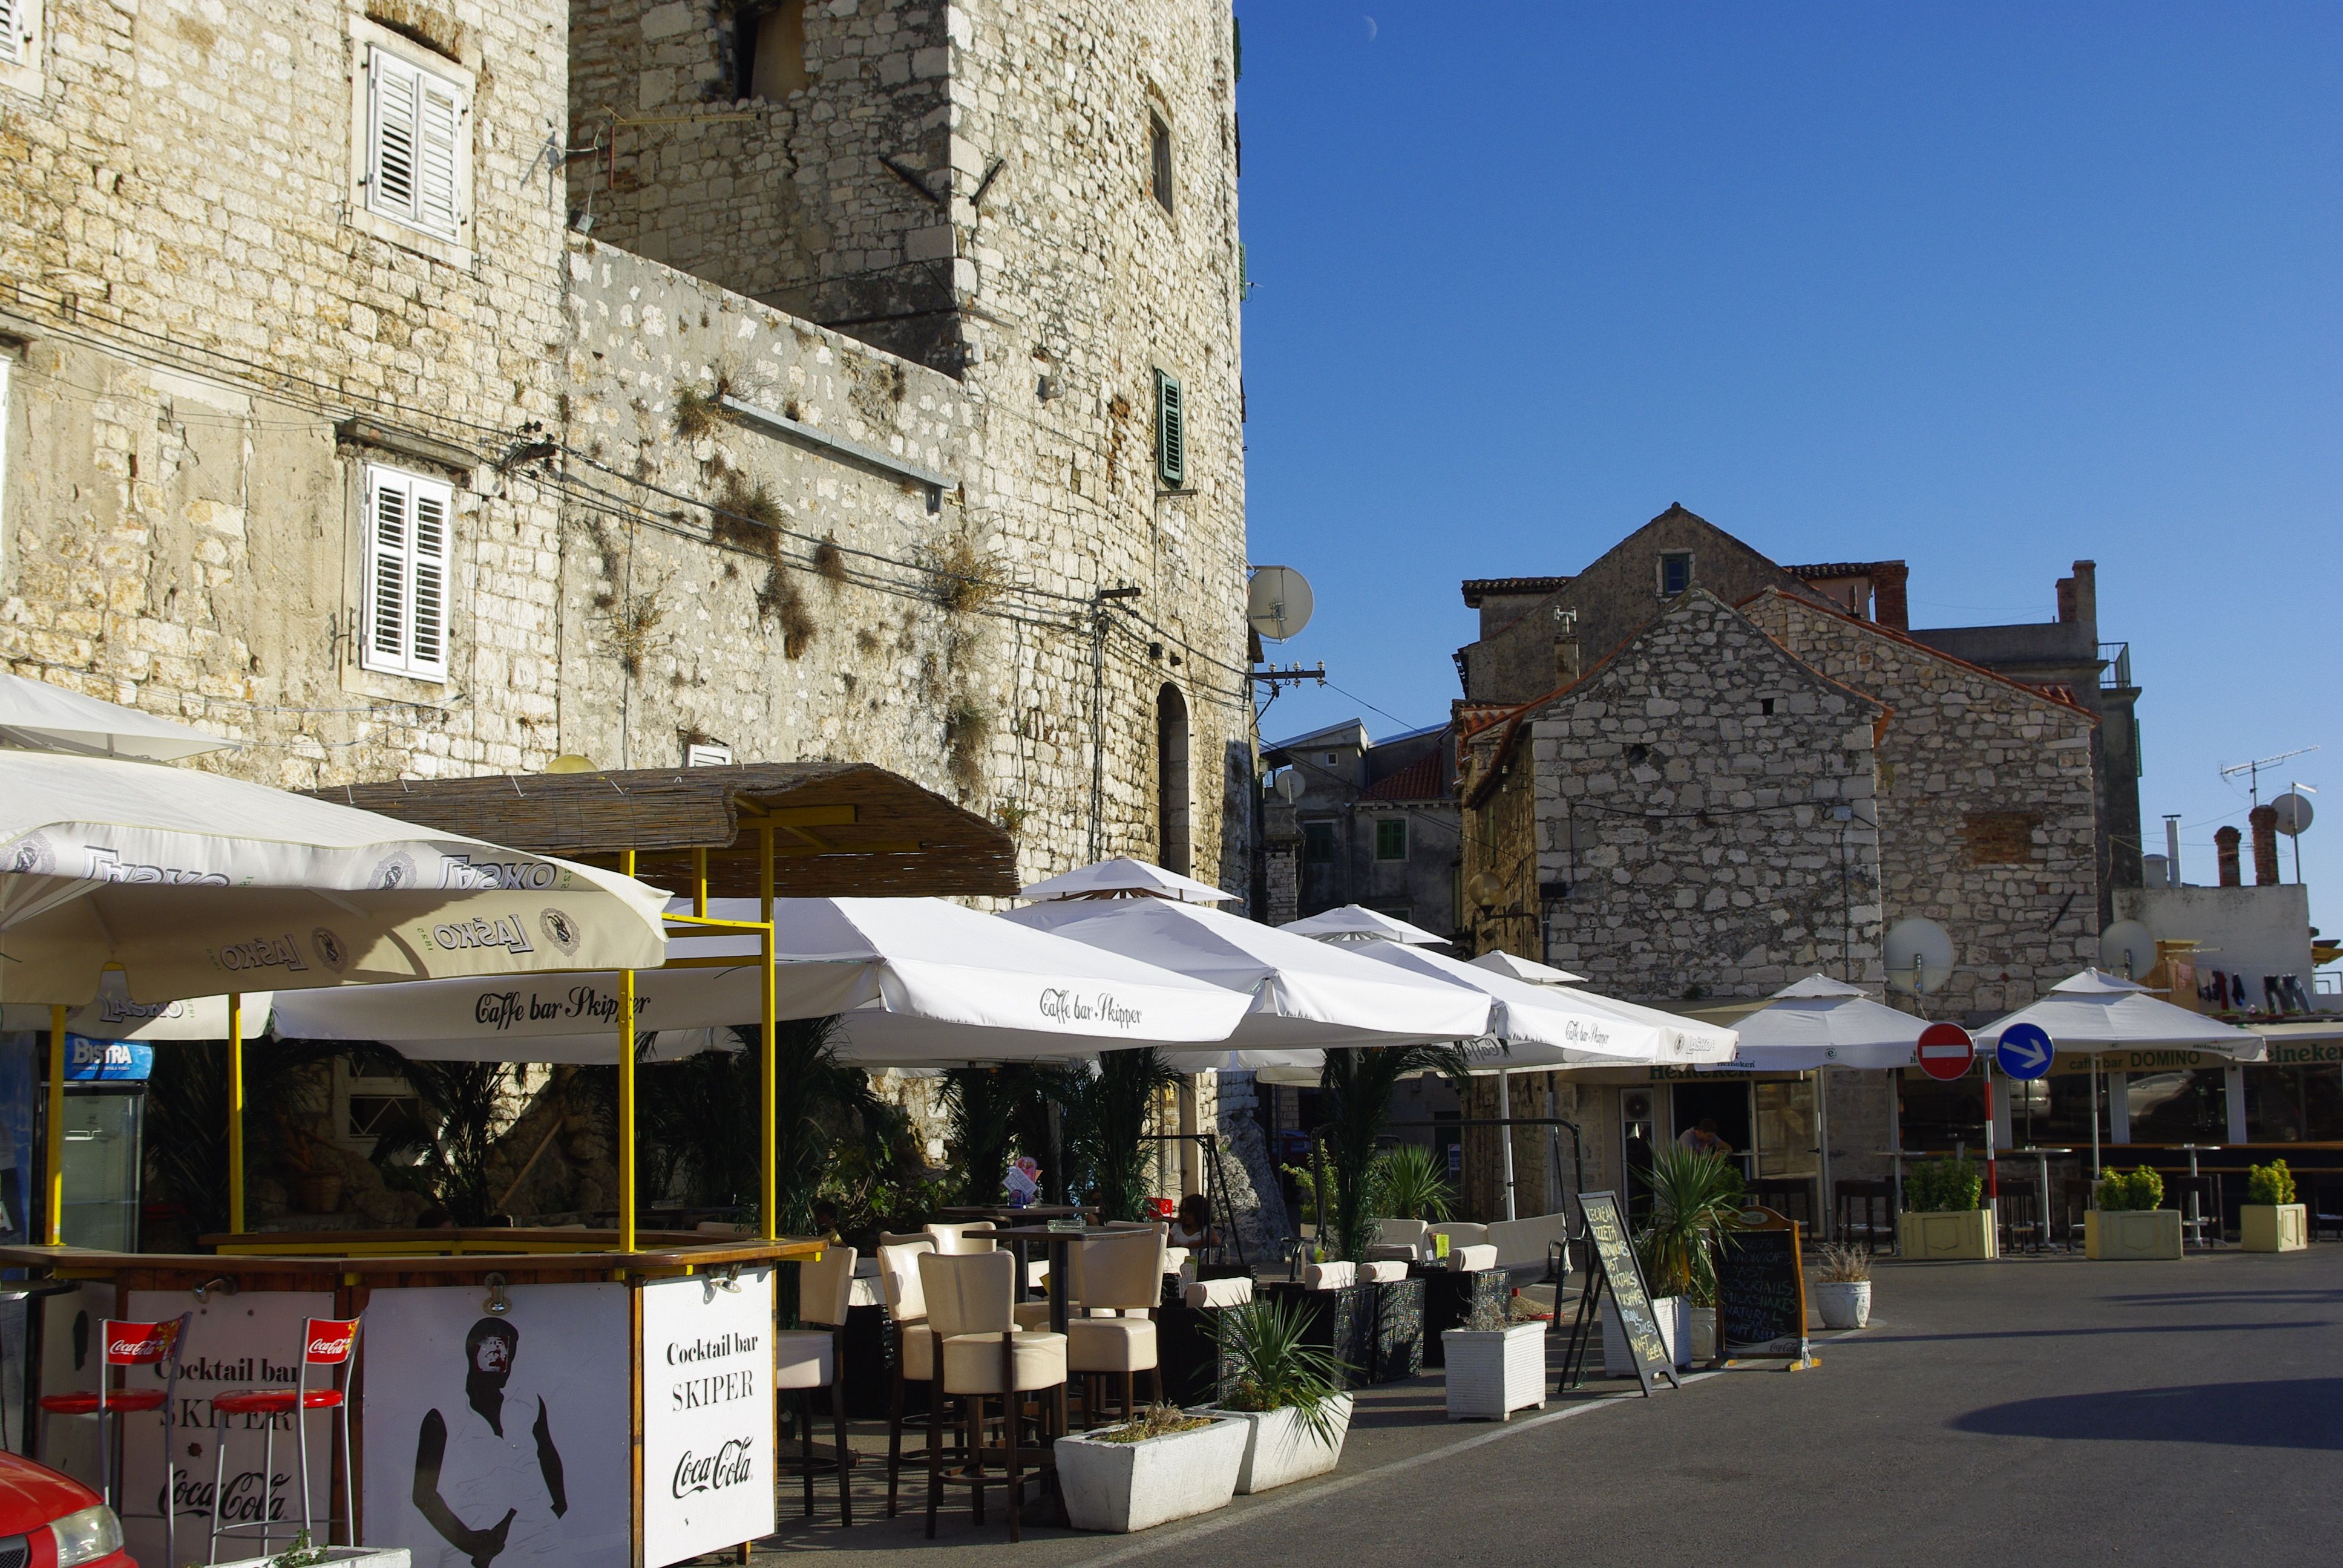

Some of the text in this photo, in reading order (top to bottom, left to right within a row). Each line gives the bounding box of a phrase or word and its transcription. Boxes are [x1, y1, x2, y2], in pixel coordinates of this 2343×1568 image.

[474, 985, 650, 1030] Caffe bar Skiper
[1040, 988, 1142, 1029] Caffe bar Skipper
[72, 1037, 133, 1065] BISTRA
[2130, 1051, 2201, 1068] DOMINO
[2267, 1043, 2343, 1063] eineke
[666, 1332, 758, 1366] Cocktail bar
[1645, 1340, 1668, 1363] BEER
[672, 1370, 754, 1412] SKIPER
